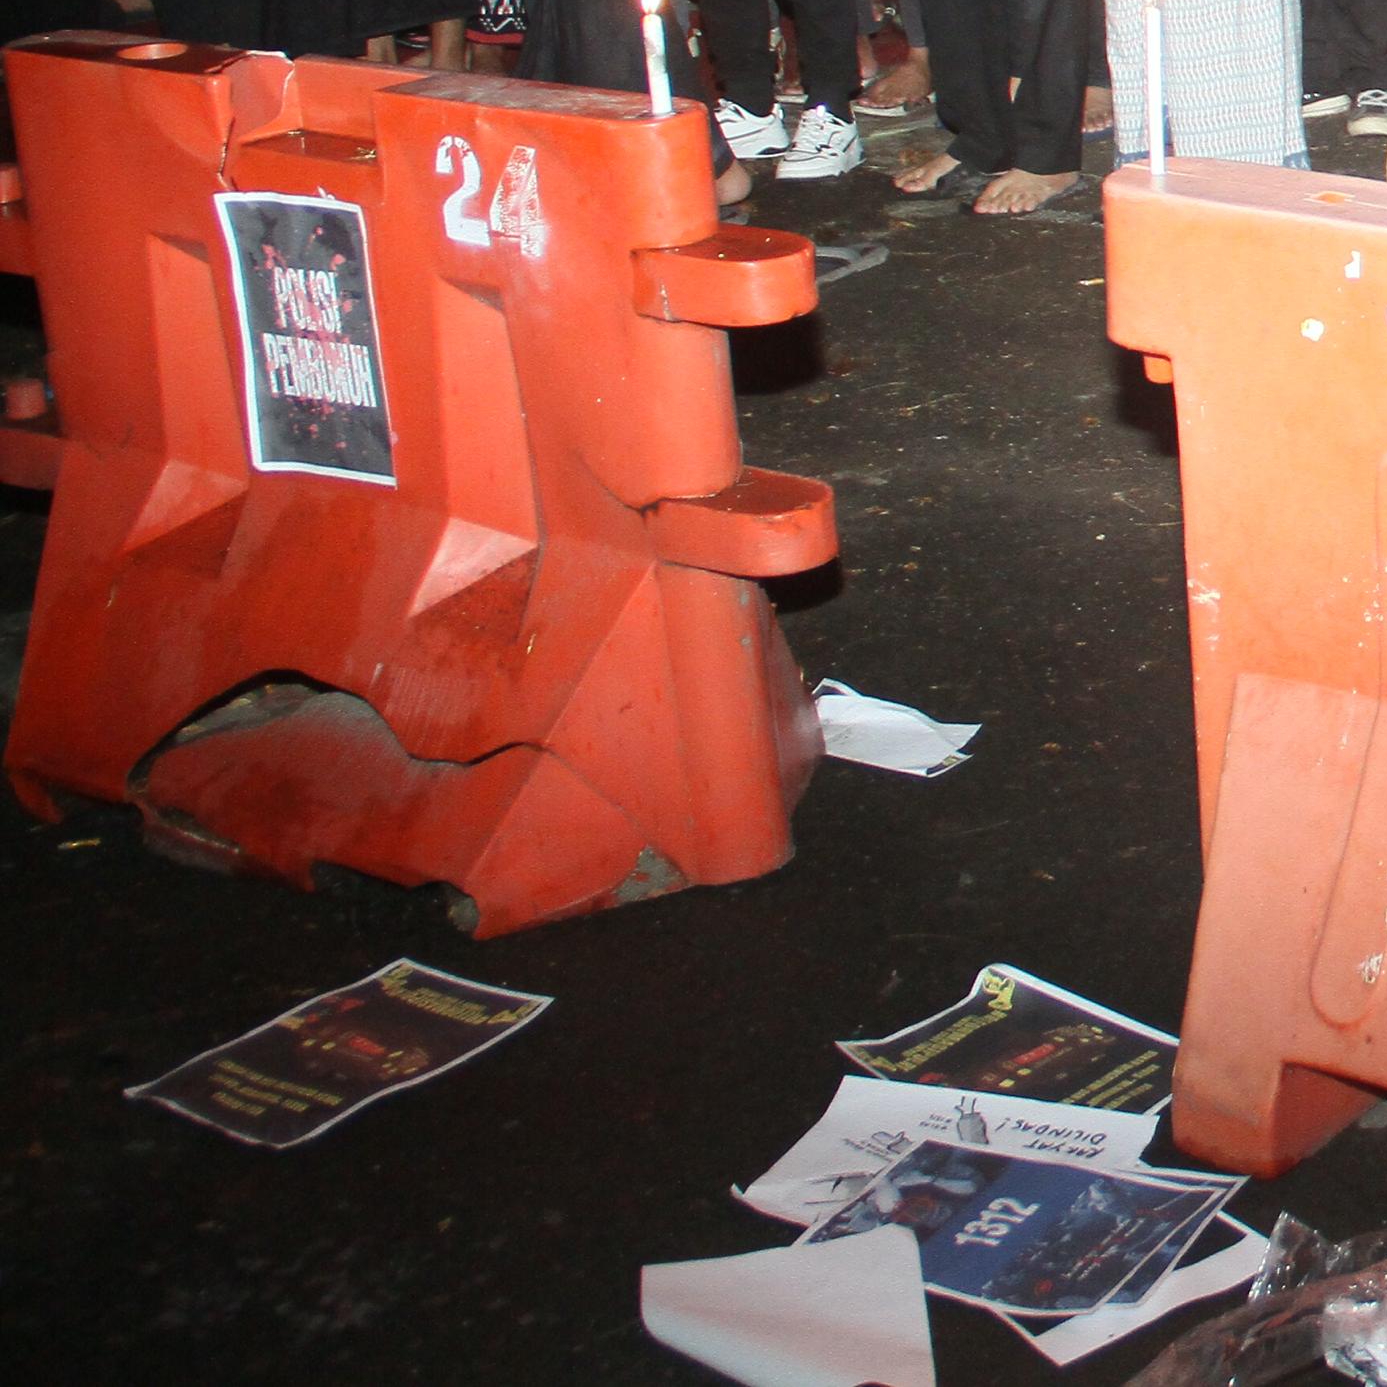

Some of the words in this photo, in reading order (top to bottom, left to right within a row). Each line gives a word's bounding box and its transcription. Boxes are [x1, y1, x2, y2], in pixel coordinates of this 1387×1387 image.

[435, 135, 548, 257] 24
[272, 265, 343, 334] POLISI
[262, 332, 378, 408] PEMBUNUH
[954, 1197, 1041, 1248] 1312
